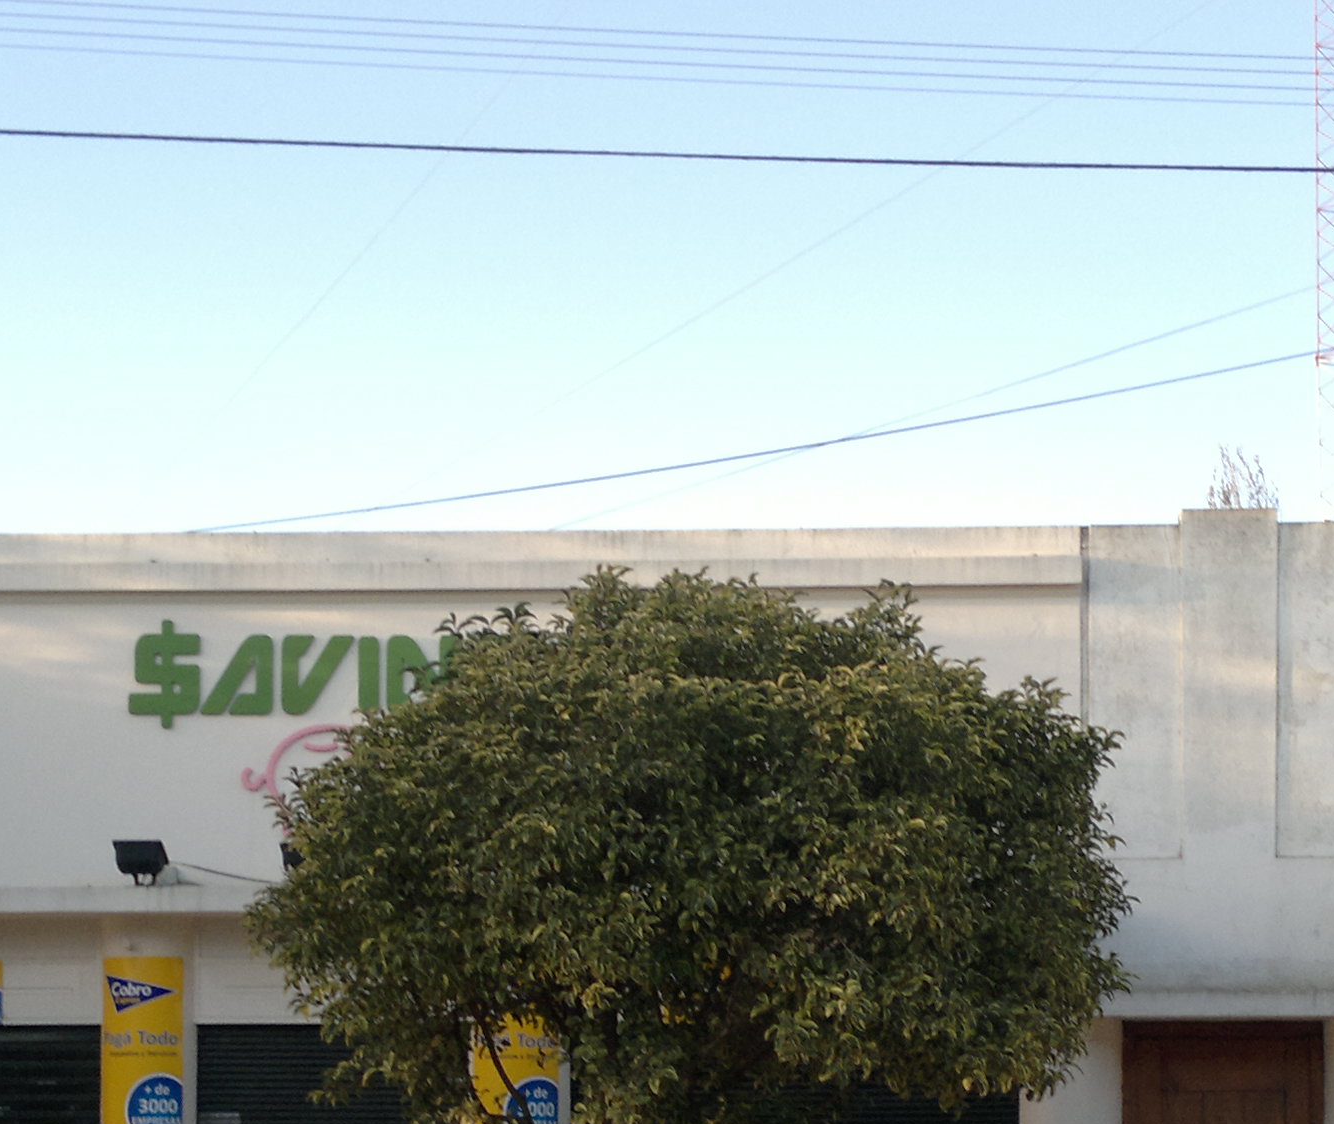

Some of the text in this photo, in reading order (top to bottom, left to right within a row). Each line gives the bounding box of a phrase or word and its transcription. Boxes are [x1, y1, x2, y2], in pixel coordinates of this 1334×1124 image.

[111, 981, 152, 997] Cobro
[138, 1030, 179, 1045] Todo
[154, 1083, 170, 1095] de
[533, 1087, 548, 1099] de
[138, 1098, 178, 1114] 3000
